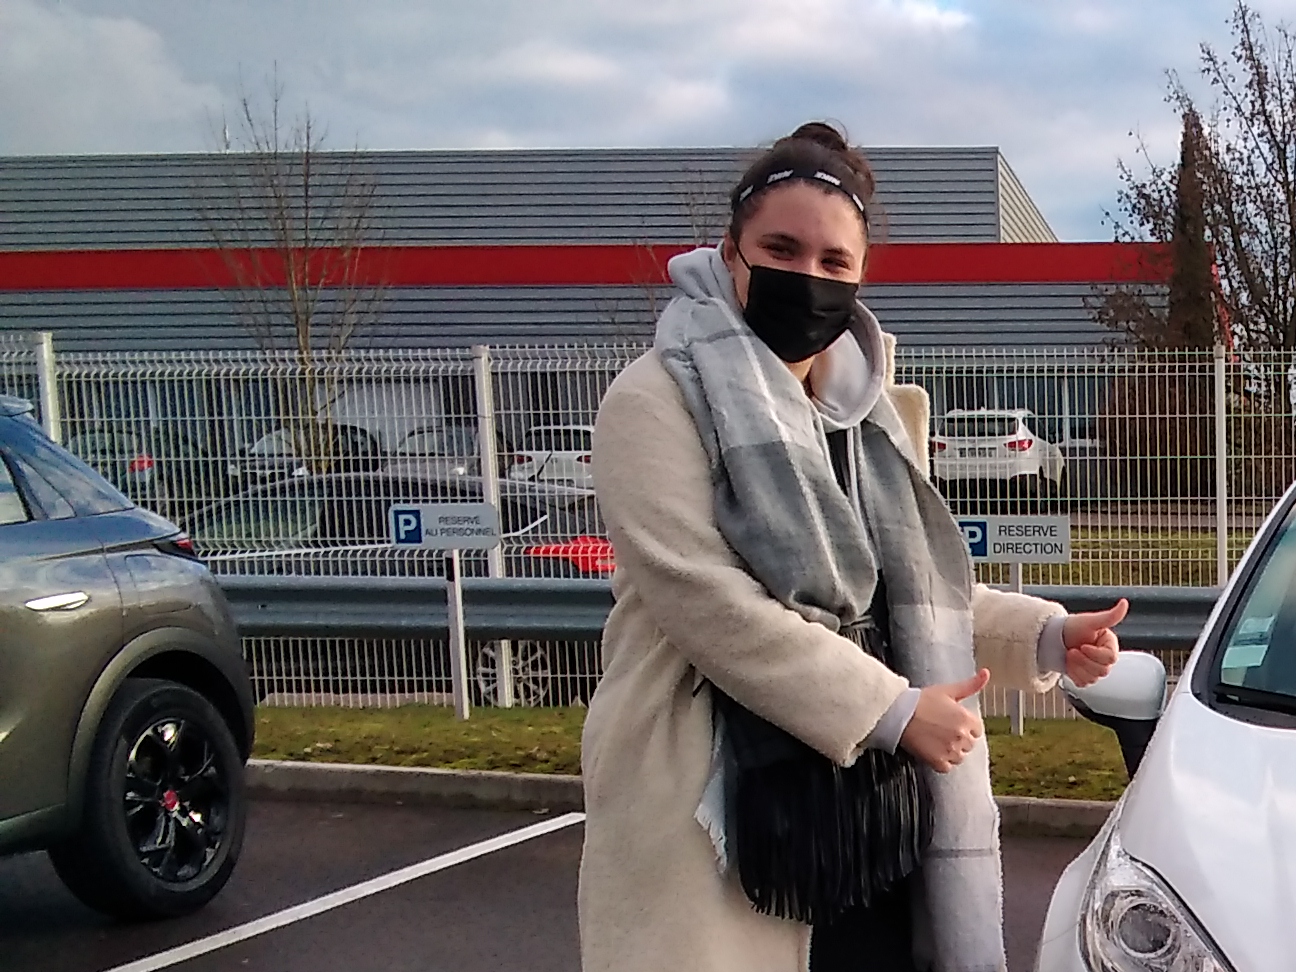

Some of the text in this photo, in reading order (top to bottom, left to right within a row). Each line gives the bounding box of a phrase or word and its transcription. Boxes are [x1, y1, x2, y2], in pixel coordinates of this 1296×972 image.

[398, 514, 417, 540] P
[425, 527, 496, 537] AU PERSONNEL
[998, 525, 1058, 537] RESERVE
[963, 526, 983, 553] P
[993, 542, 1064, 555] DIRECTION
